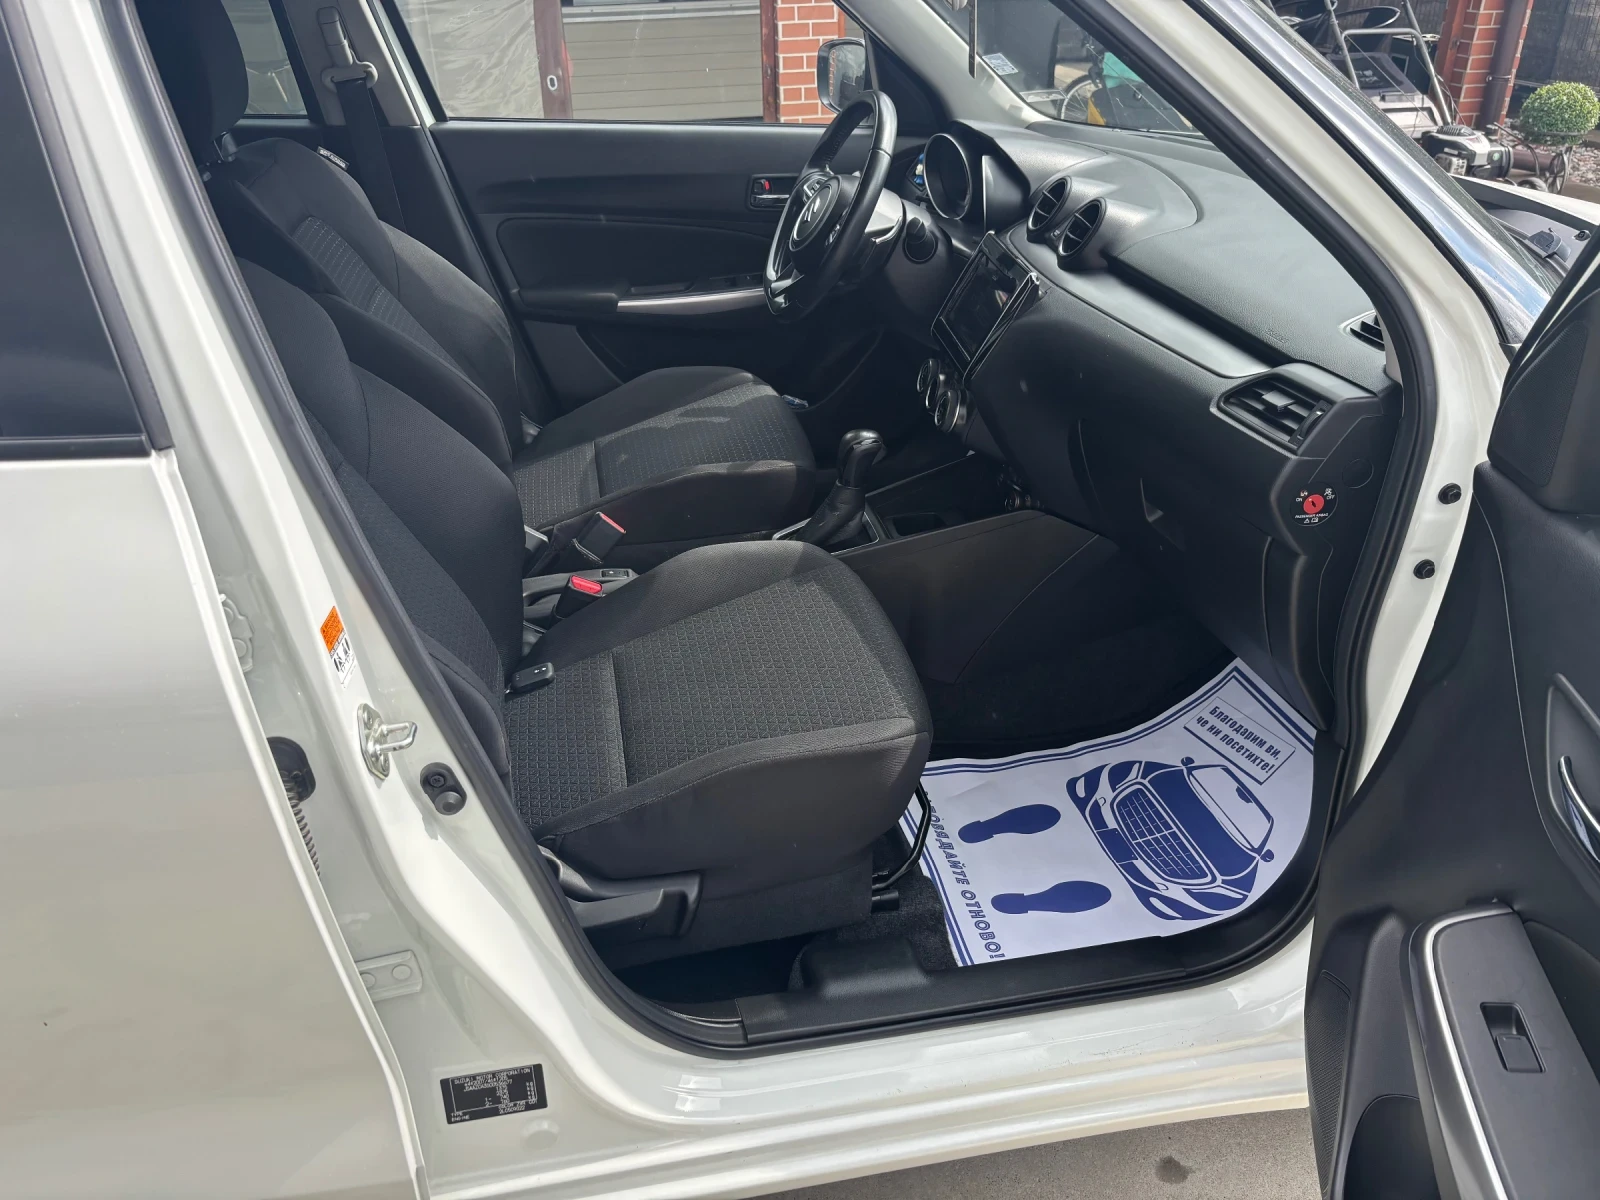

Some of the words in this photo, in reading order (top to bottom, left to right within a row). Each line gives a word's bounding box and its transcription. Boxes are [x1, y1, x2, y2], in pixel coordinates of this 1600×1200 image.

[1196, 715, 1209, 728] че
[1207, 724, 1222, 737] ни
[1219, 733, 1276, 774] посетихте!
[1209, 705, 1267, 749] Благодарим
[1264, 744, 1282, 761] ви,
[928, 799, 970, 885] ОВЯДАЙТЕ
[961, 889, 1006, 959] ОТНОВО!
